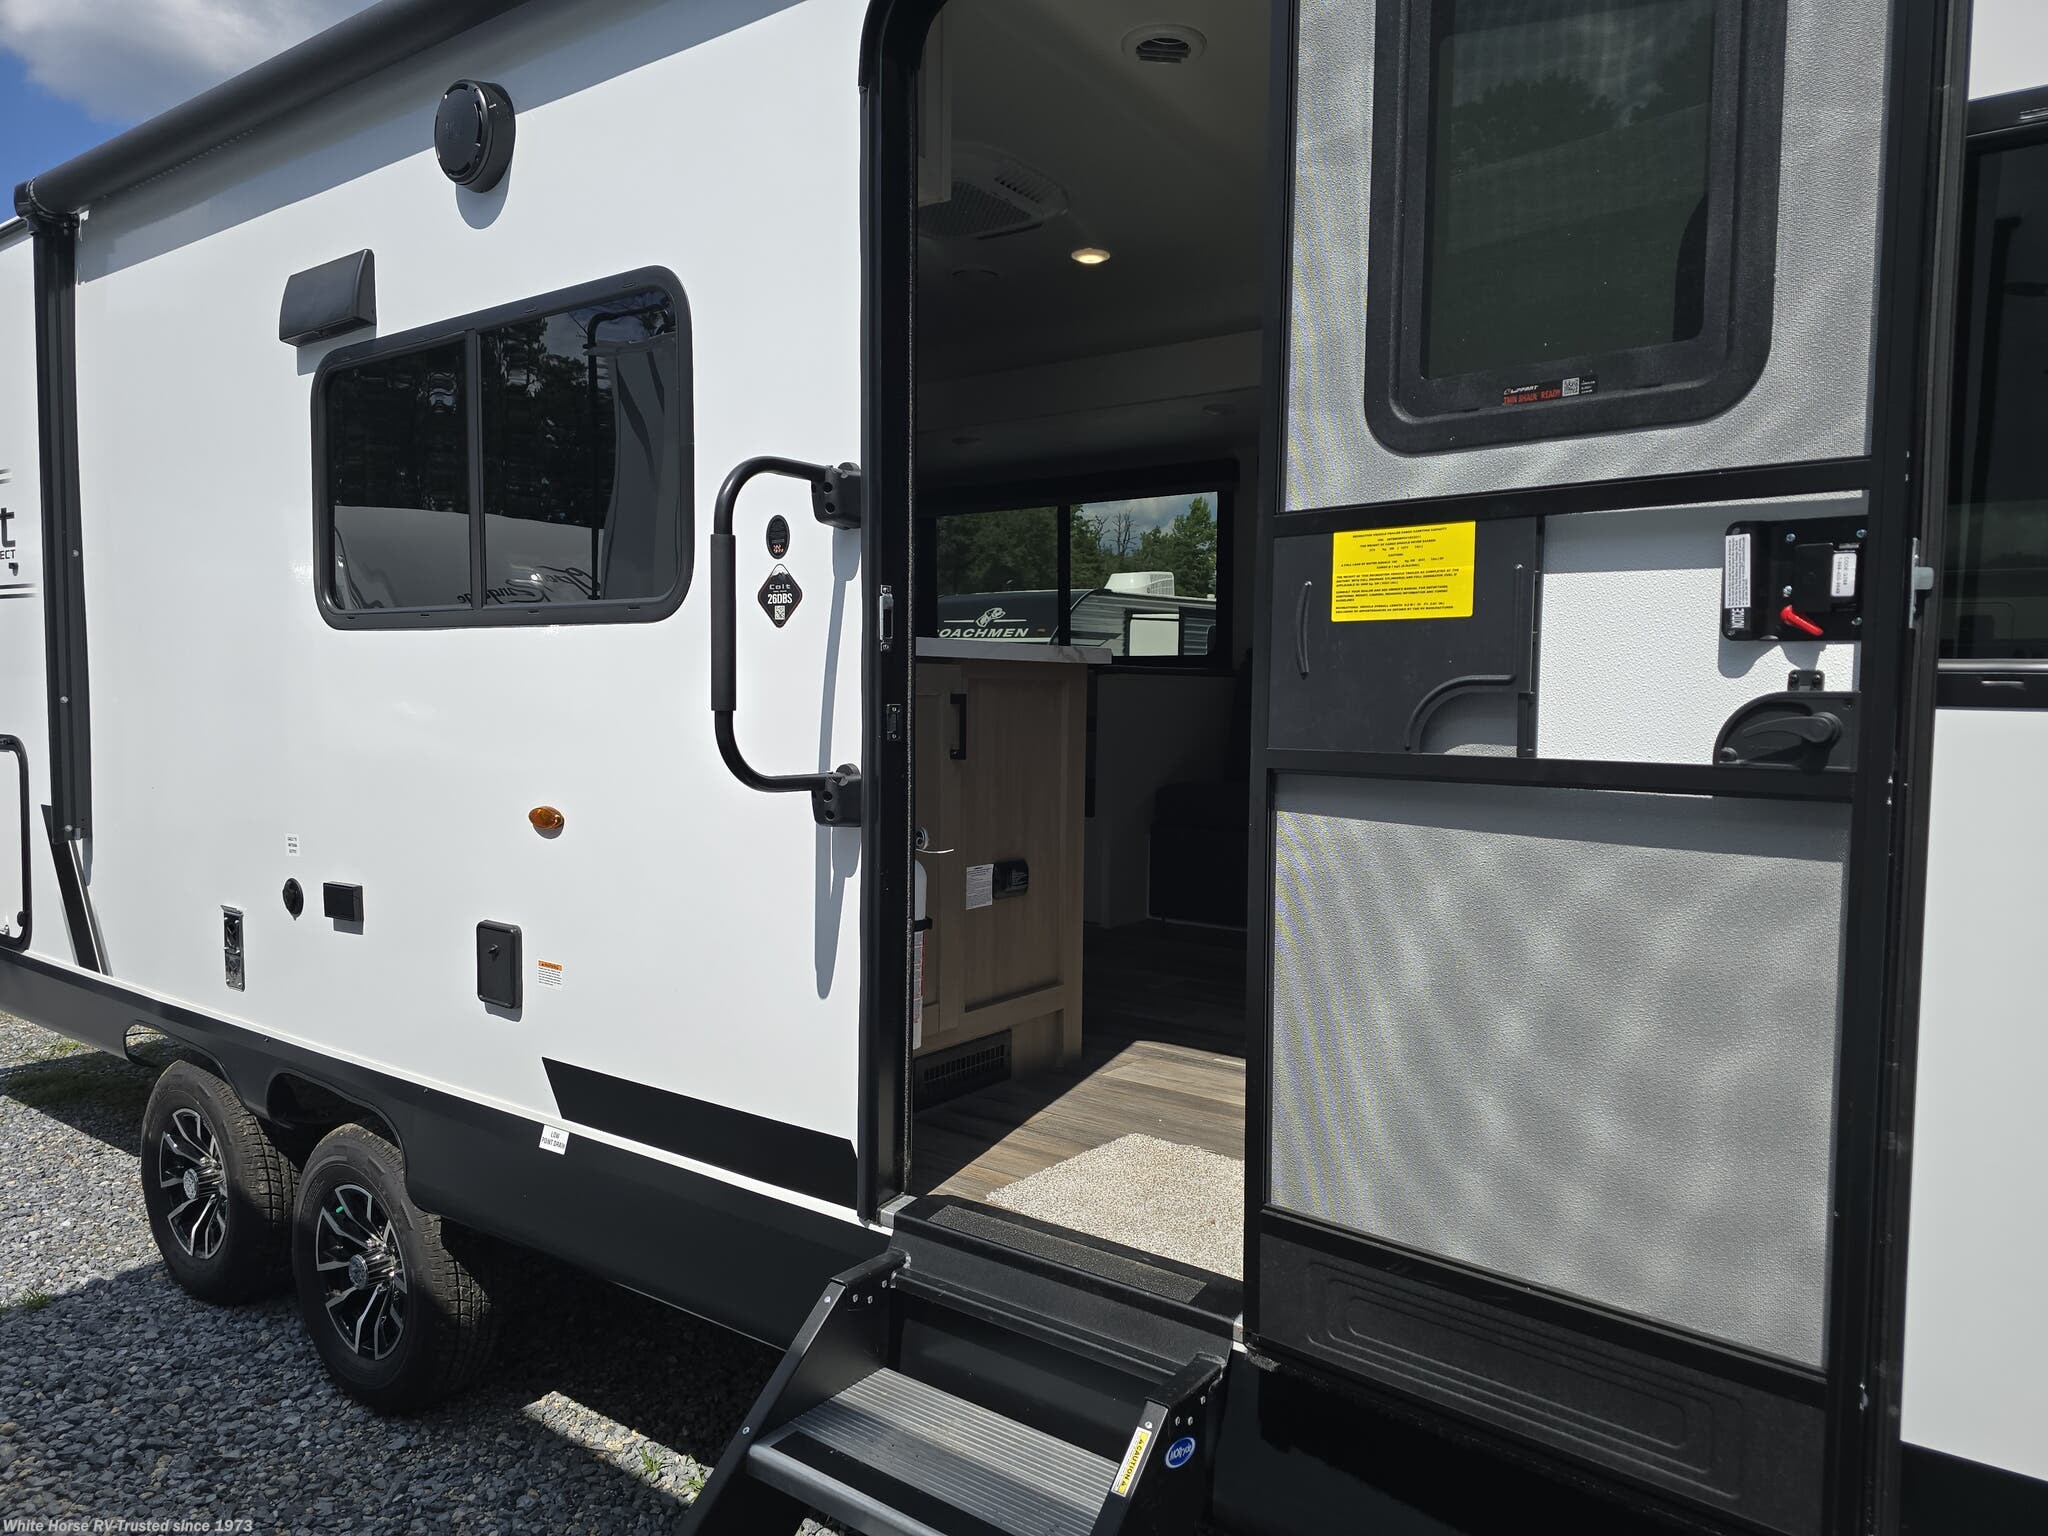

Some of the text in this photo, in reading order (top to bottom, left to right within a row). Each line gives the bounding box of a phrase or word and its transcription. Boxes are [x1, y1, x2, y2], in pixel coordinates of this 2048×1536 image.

[767, 593, 793, 605] 26DBS
[1731, 608, 1745, 629] NOTICE
[937, 627, 1030, 638] OACHMEN
[1124, 1445, 1143, 1480] CAUTION
